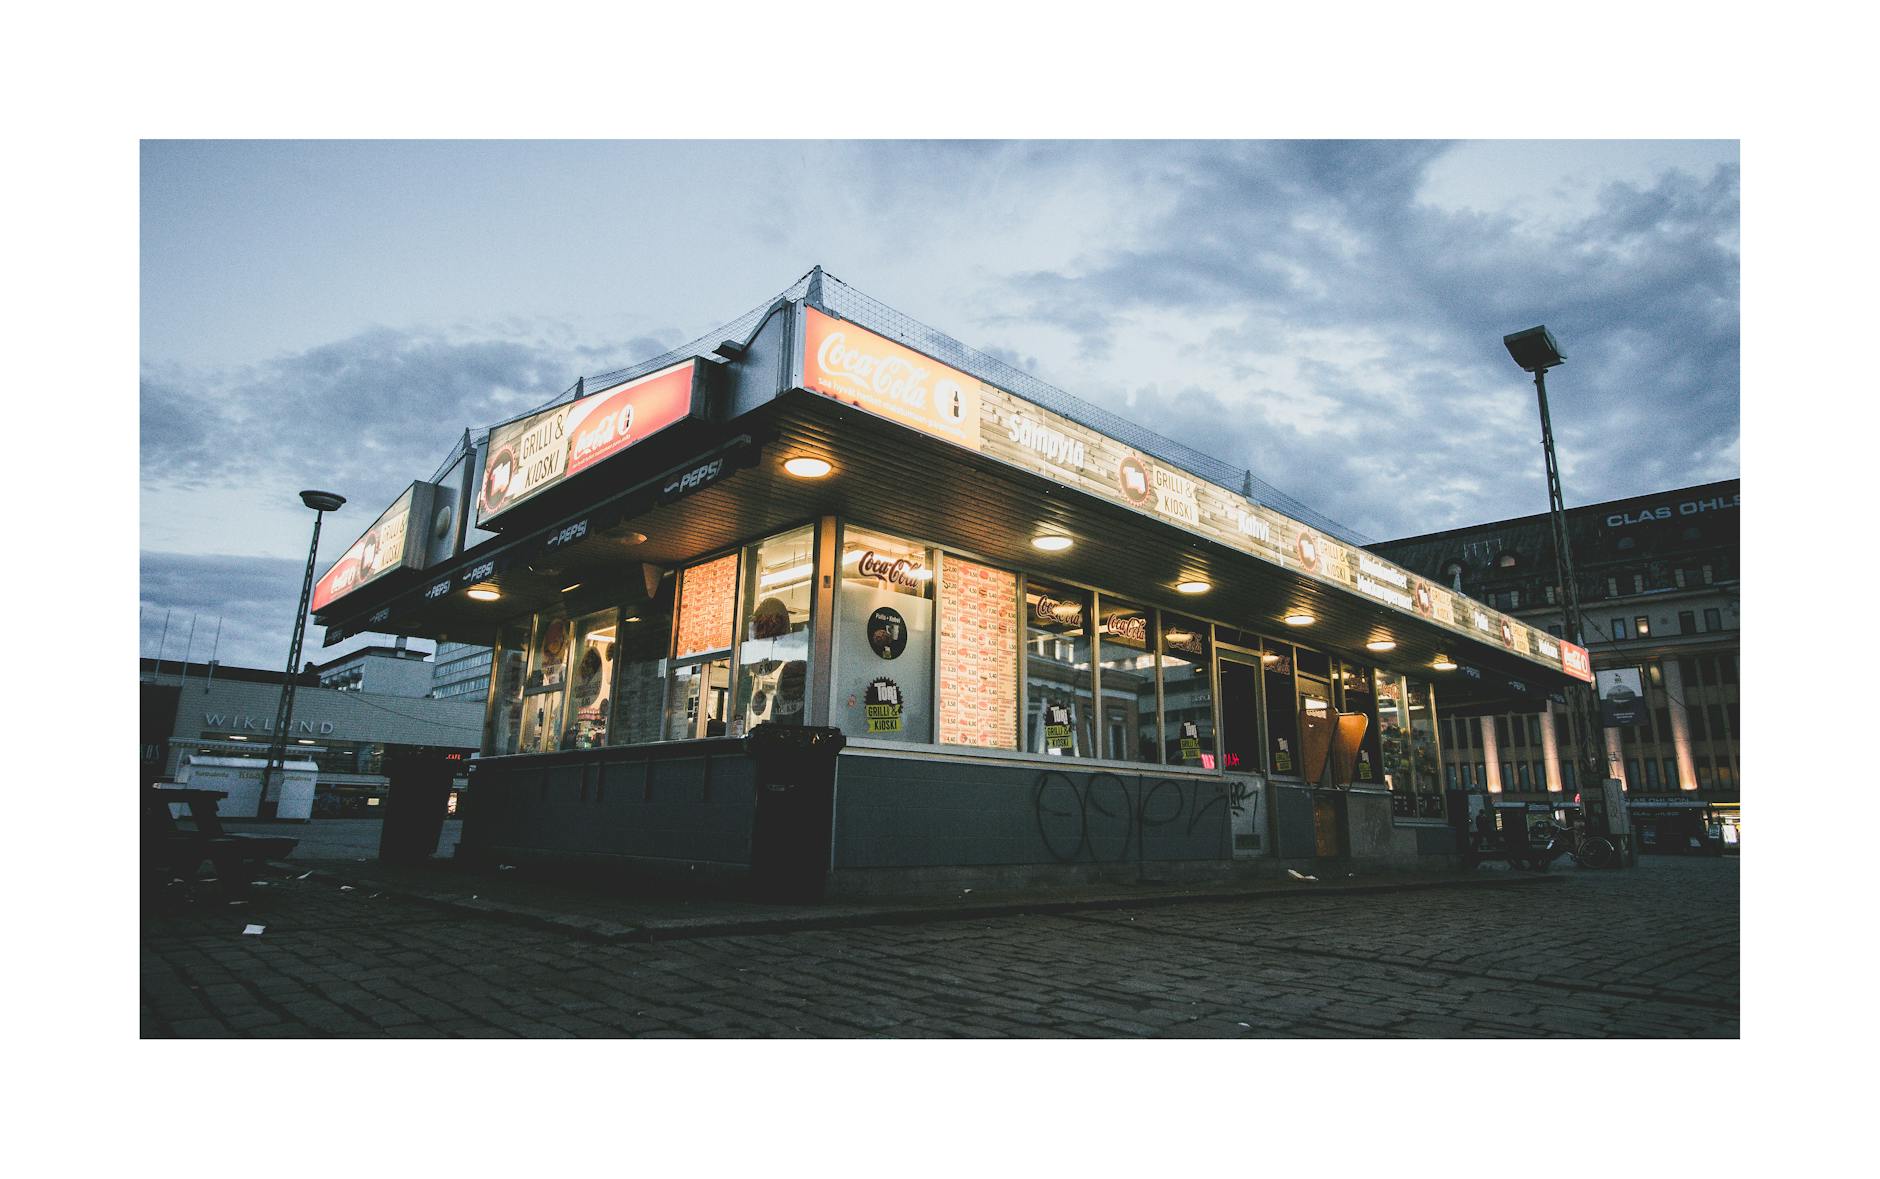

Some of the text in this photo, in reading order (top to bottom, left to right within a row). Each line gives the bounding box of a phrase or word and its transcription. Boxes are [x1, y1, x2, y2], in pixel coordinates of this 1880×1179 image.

[817, 332, 931, 408] Coca-Cola
[523, 420, 551, 460] GRILLI
[555, 414, 564, 440] &
[525, 450, 560, 489] KIOSKI
[679, 458, 723, 493] PEPSI
[1156, 470, 1194, 498] GRILLI &
[1164, 495, 1194, 521] KIOSKI
[1607, 506, 1672, 527] CLAS
[557, 519, 588, 546] PEPSI
[471, 560, 495, 581] PEPSI
[206, 712, 334, 734] WIKLUND
[868, 706, 890, 717] GRILLI
[875, 720, 897, 730] KIOSKI
